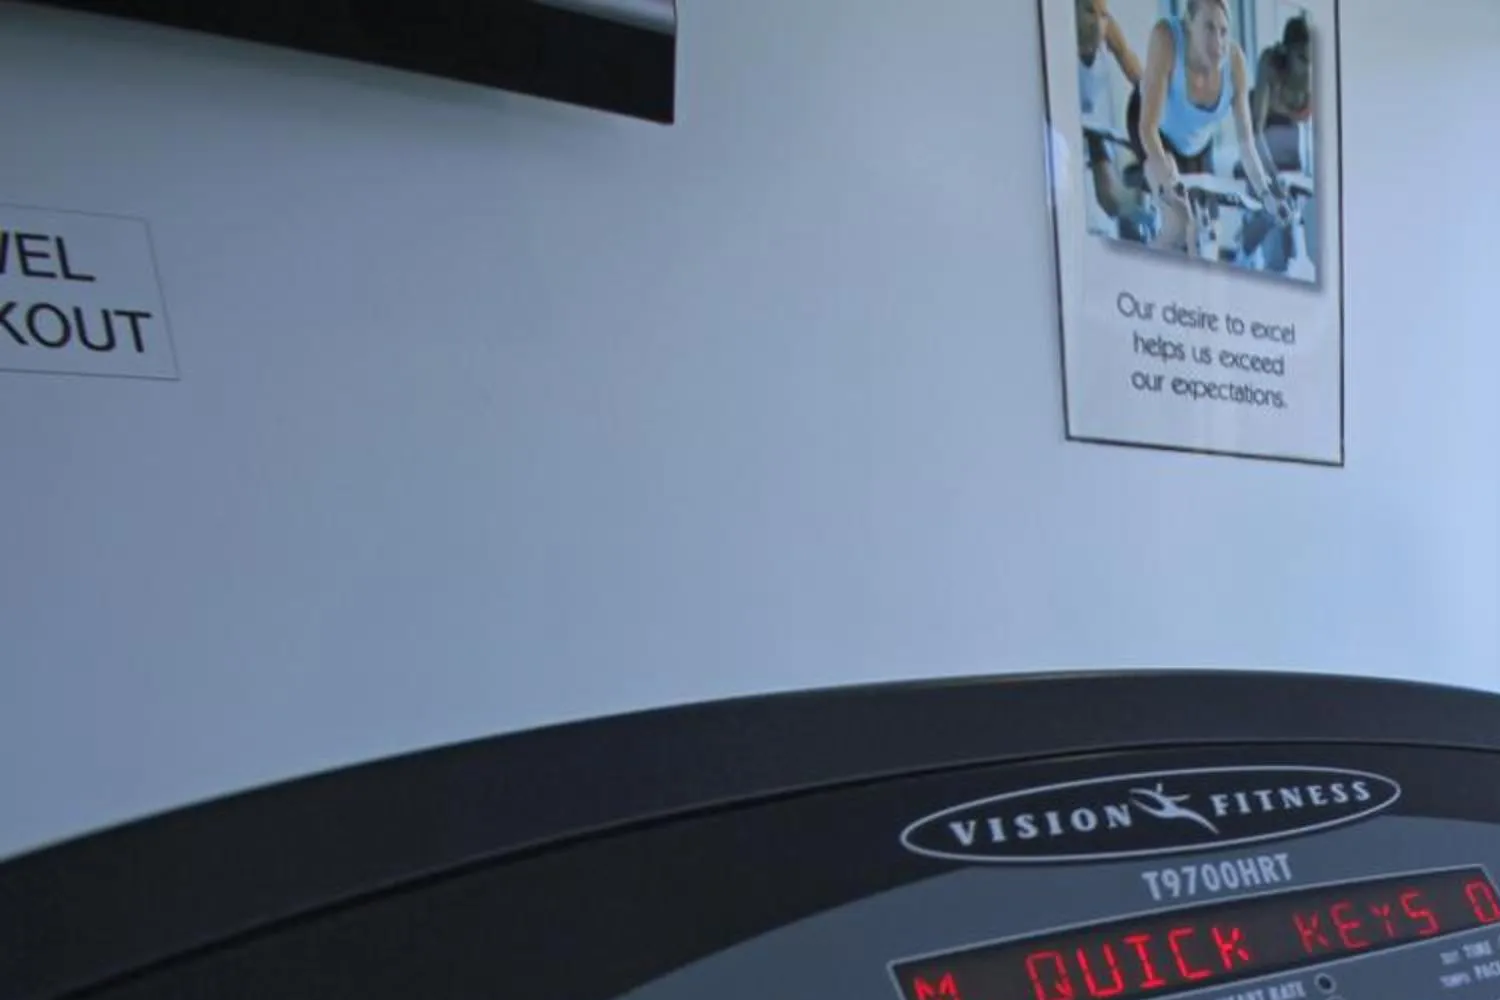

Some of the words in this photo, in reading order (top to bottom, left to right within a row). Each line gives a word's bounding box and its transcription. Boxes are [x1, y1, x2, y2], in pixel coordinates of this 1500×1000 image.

[0, 230, 96, 282] EL
[1117, 292, 1154, 320] Our
[1162, 302, 1219, 332] desire
[1225, 313, 1244, 337] to
[1251, 322, 1295, 345] excel
[1133, 331, 1185, 364] helps
[1192, 346, 1212, 365] us
[1219, 350, 1285, 376] exceed
[1131, 370, 1164, 392] our
[1171, 378, 1287, 409] expectations.
[949, 802, 1133, 847] VISION
[1209, 780, 1371, 817] FITNESS
[1142, 852, 1294, 900] T9700HRT
[1293, 891, 1439, 954] KEYS
